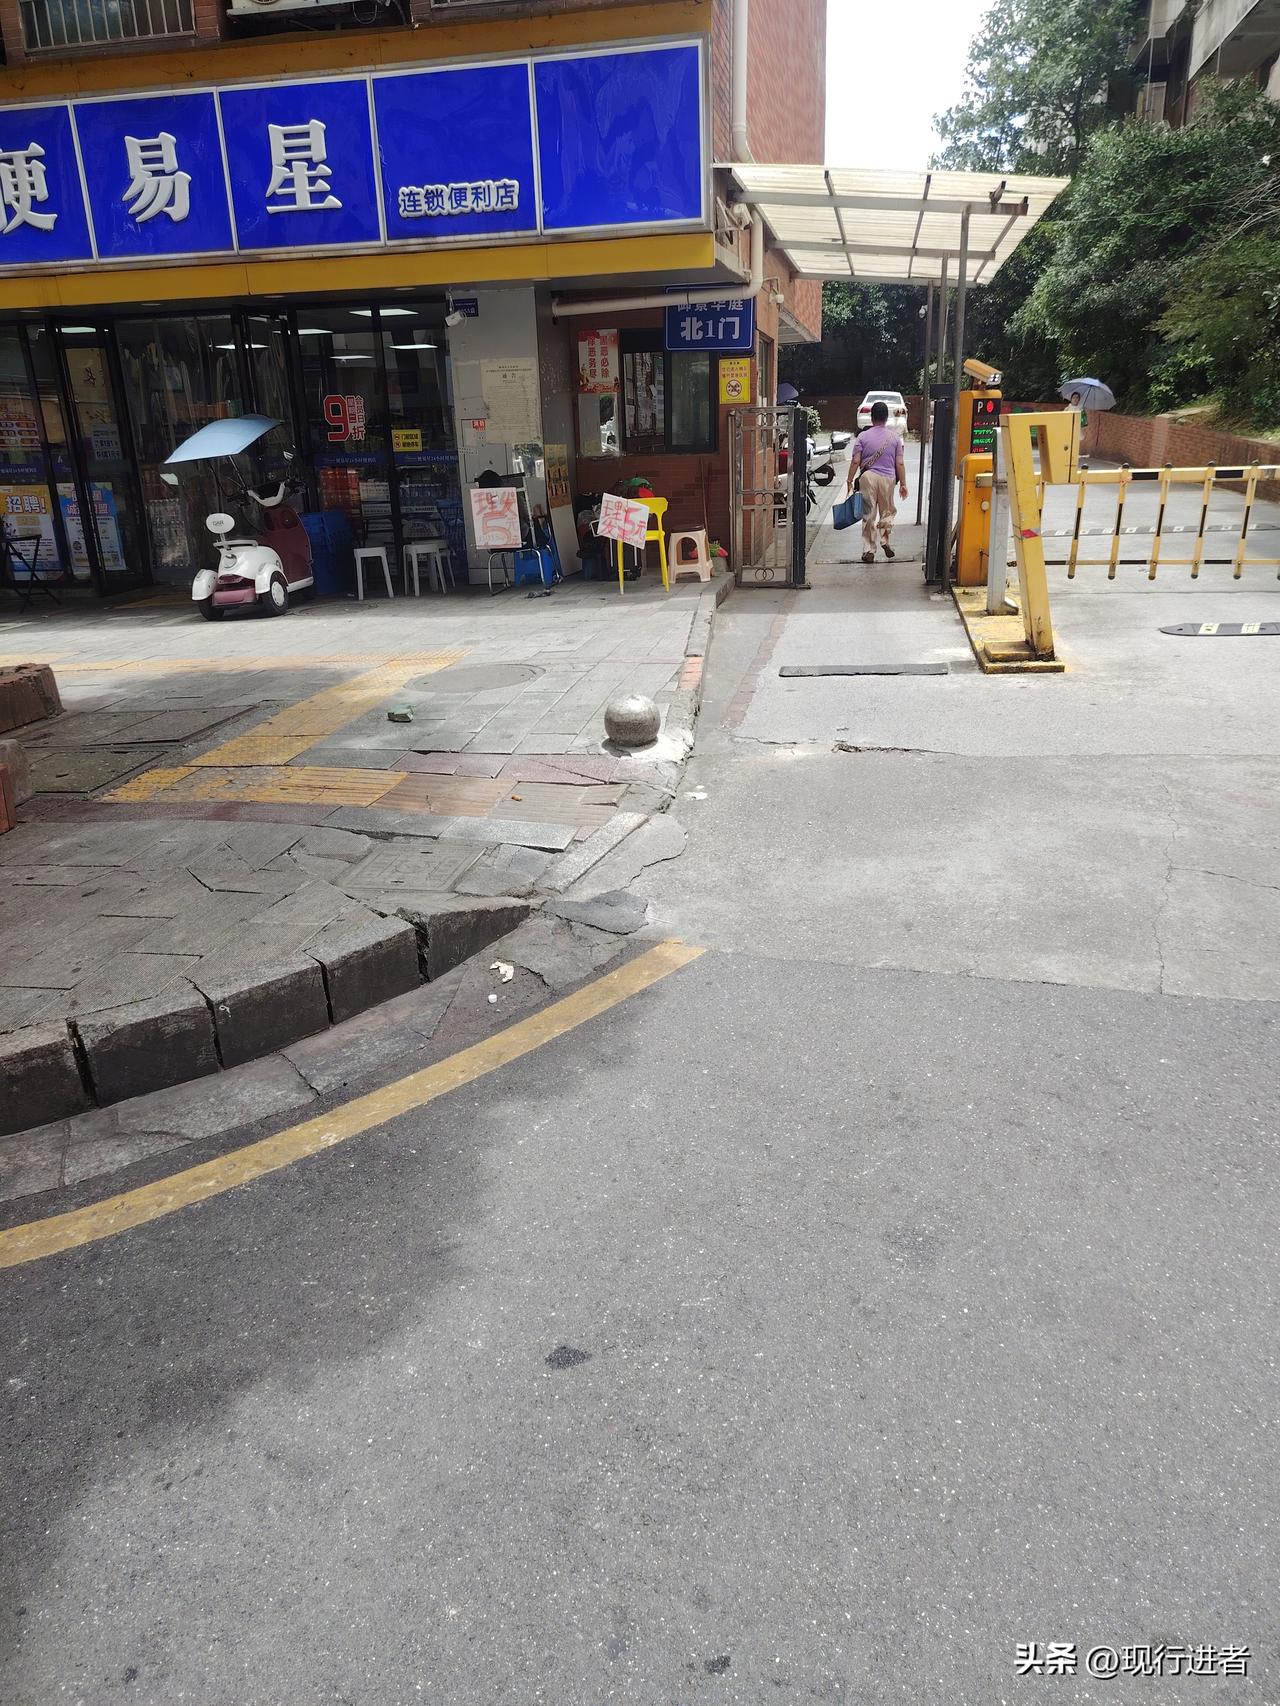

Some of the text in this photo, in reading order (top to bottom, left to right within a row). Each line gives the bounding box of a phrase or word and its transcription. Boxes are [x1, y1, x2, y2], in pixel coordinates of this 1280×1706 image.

[398, 178, 520, 219] 连锁便利店
[680, 316, 740, 341] 北1门
[323, 394, 366, 441] 9 折
[977, 401, 984, 413] P
[6, 494, 47, 513] 招聘!
[600, 500, 623, 538] 理发
